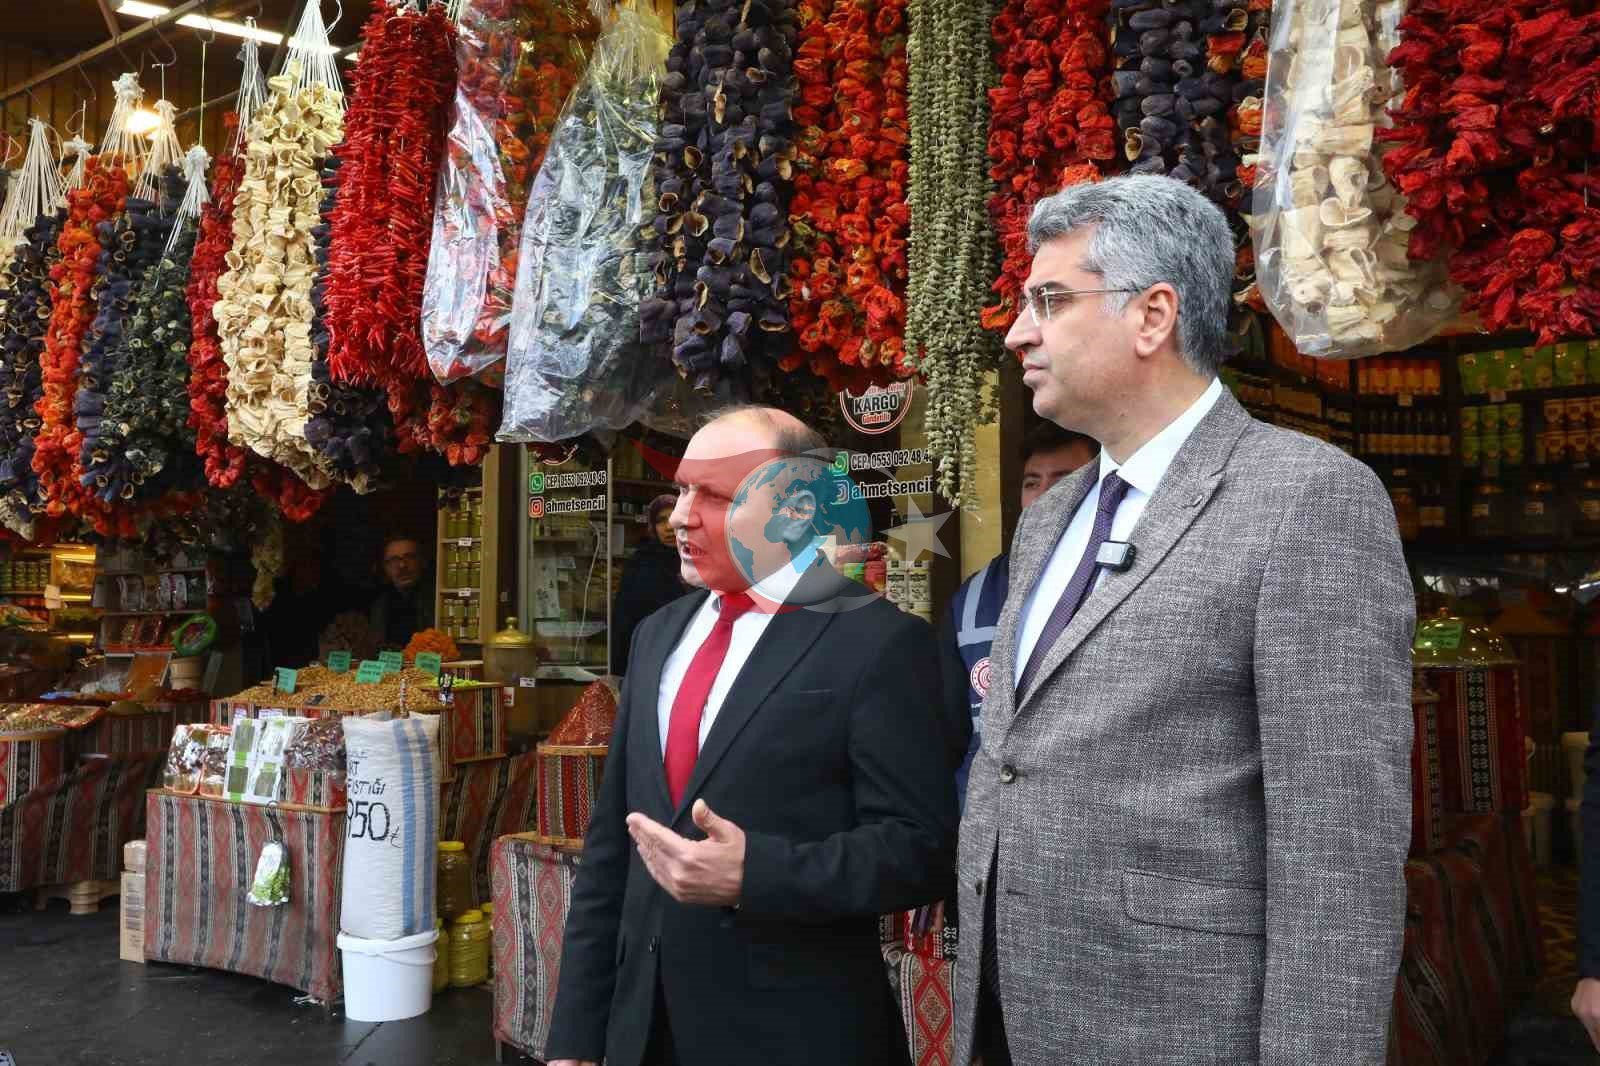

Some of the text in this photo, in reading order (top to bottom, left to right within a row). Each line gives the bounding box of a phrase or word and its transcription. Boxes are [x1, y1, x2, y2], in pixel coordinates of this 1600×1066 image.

[854, 393, 899, 414] KARGO
[871, 451, 892, 468] 0553
[893, 449, 909, 467] 092
[910, 447, 921, 464] 48
